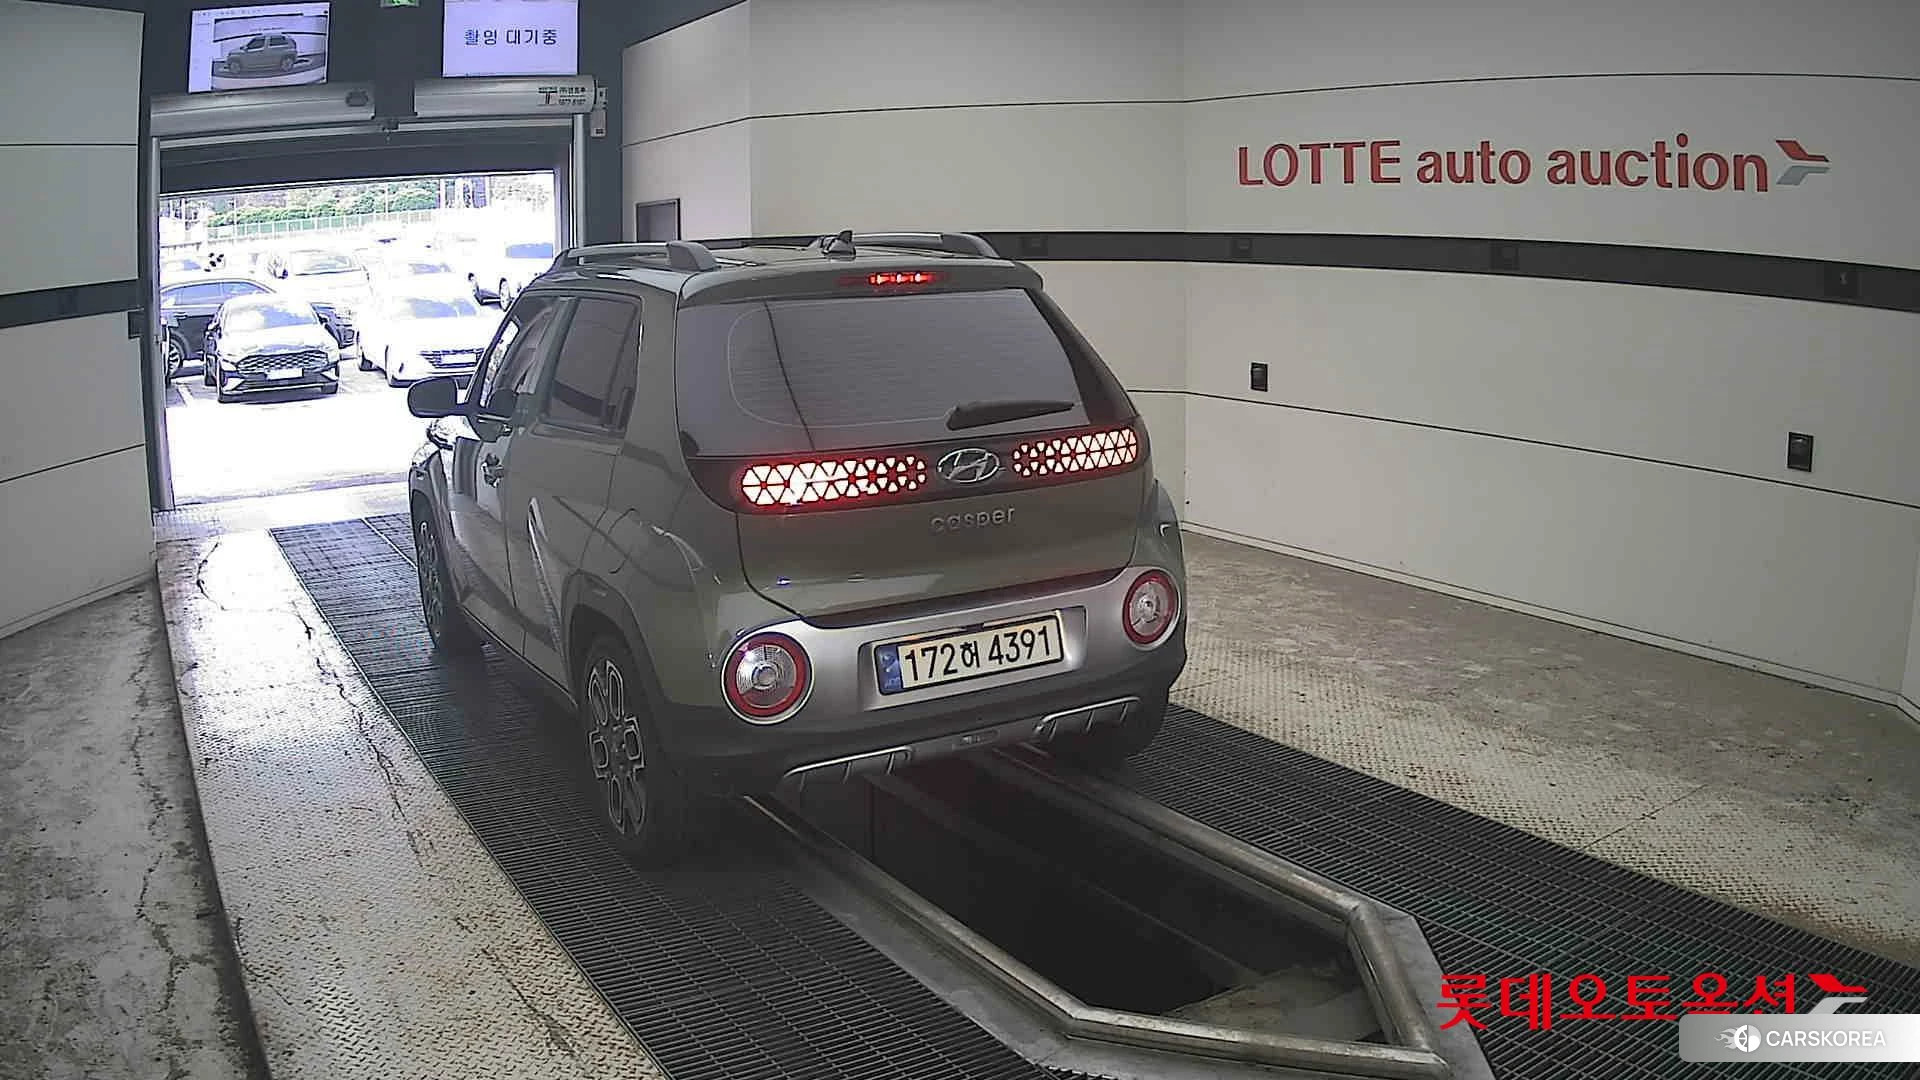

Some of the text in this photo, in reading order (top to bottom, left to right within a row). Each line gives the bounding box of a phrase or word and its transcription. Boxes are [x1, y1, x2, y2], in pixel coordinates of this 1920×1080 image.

[465, 29, 557, 46] 촬영 대기중
[1238, 133, 1769, 193] LOTTE auto auction
[931, 507, 1016, 533] casper
[904, 625, 1051, 682] 172허 4391
